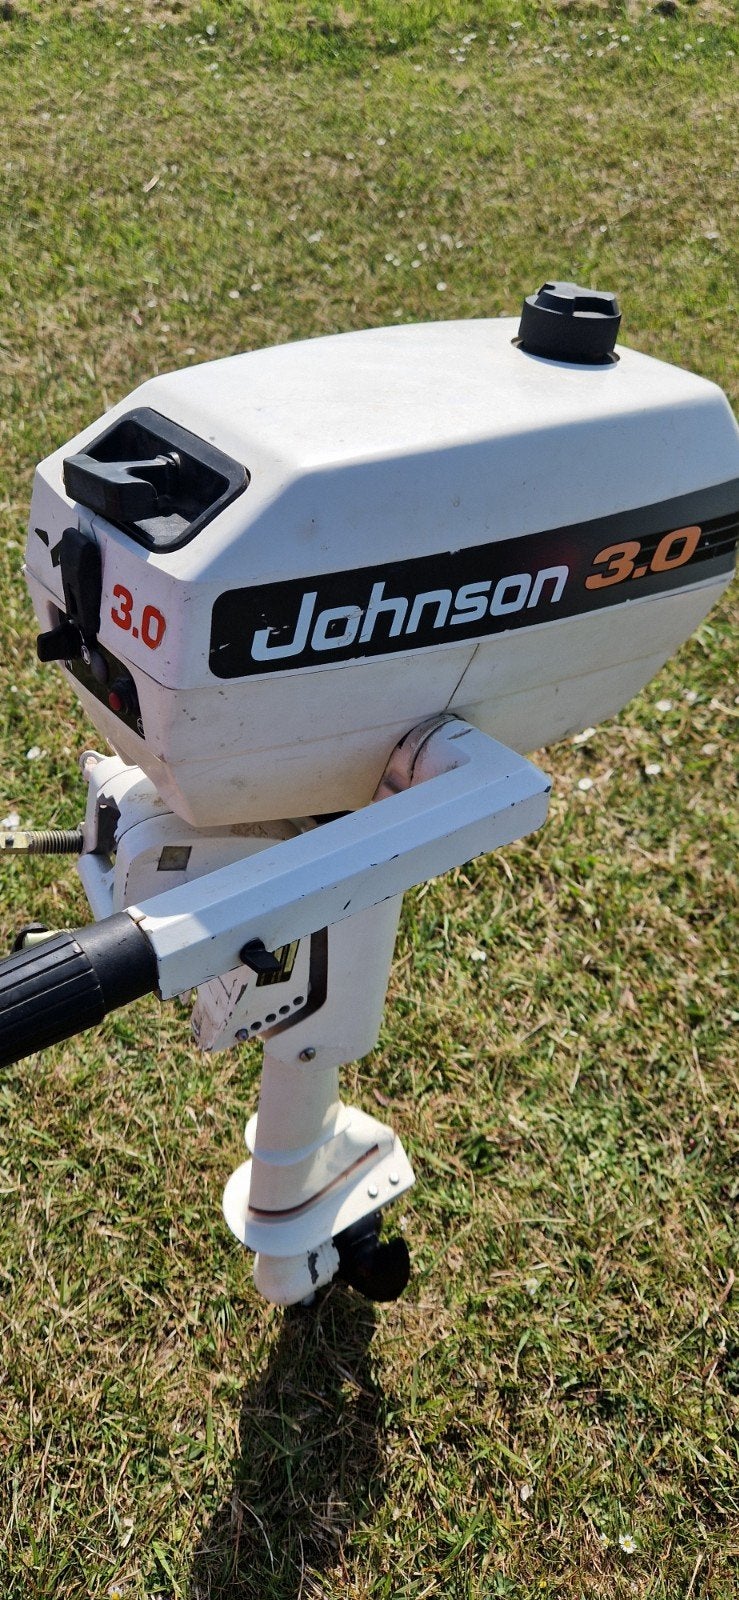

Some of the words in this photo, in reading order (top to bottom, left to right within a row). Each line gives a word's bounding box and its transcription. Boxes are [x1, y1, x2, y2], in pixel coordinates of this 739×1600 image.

[111, 584, 166, 650] 3.0
[251, 565, 569, 661] Johnson
[585, 526, 702, 590] 3.0
